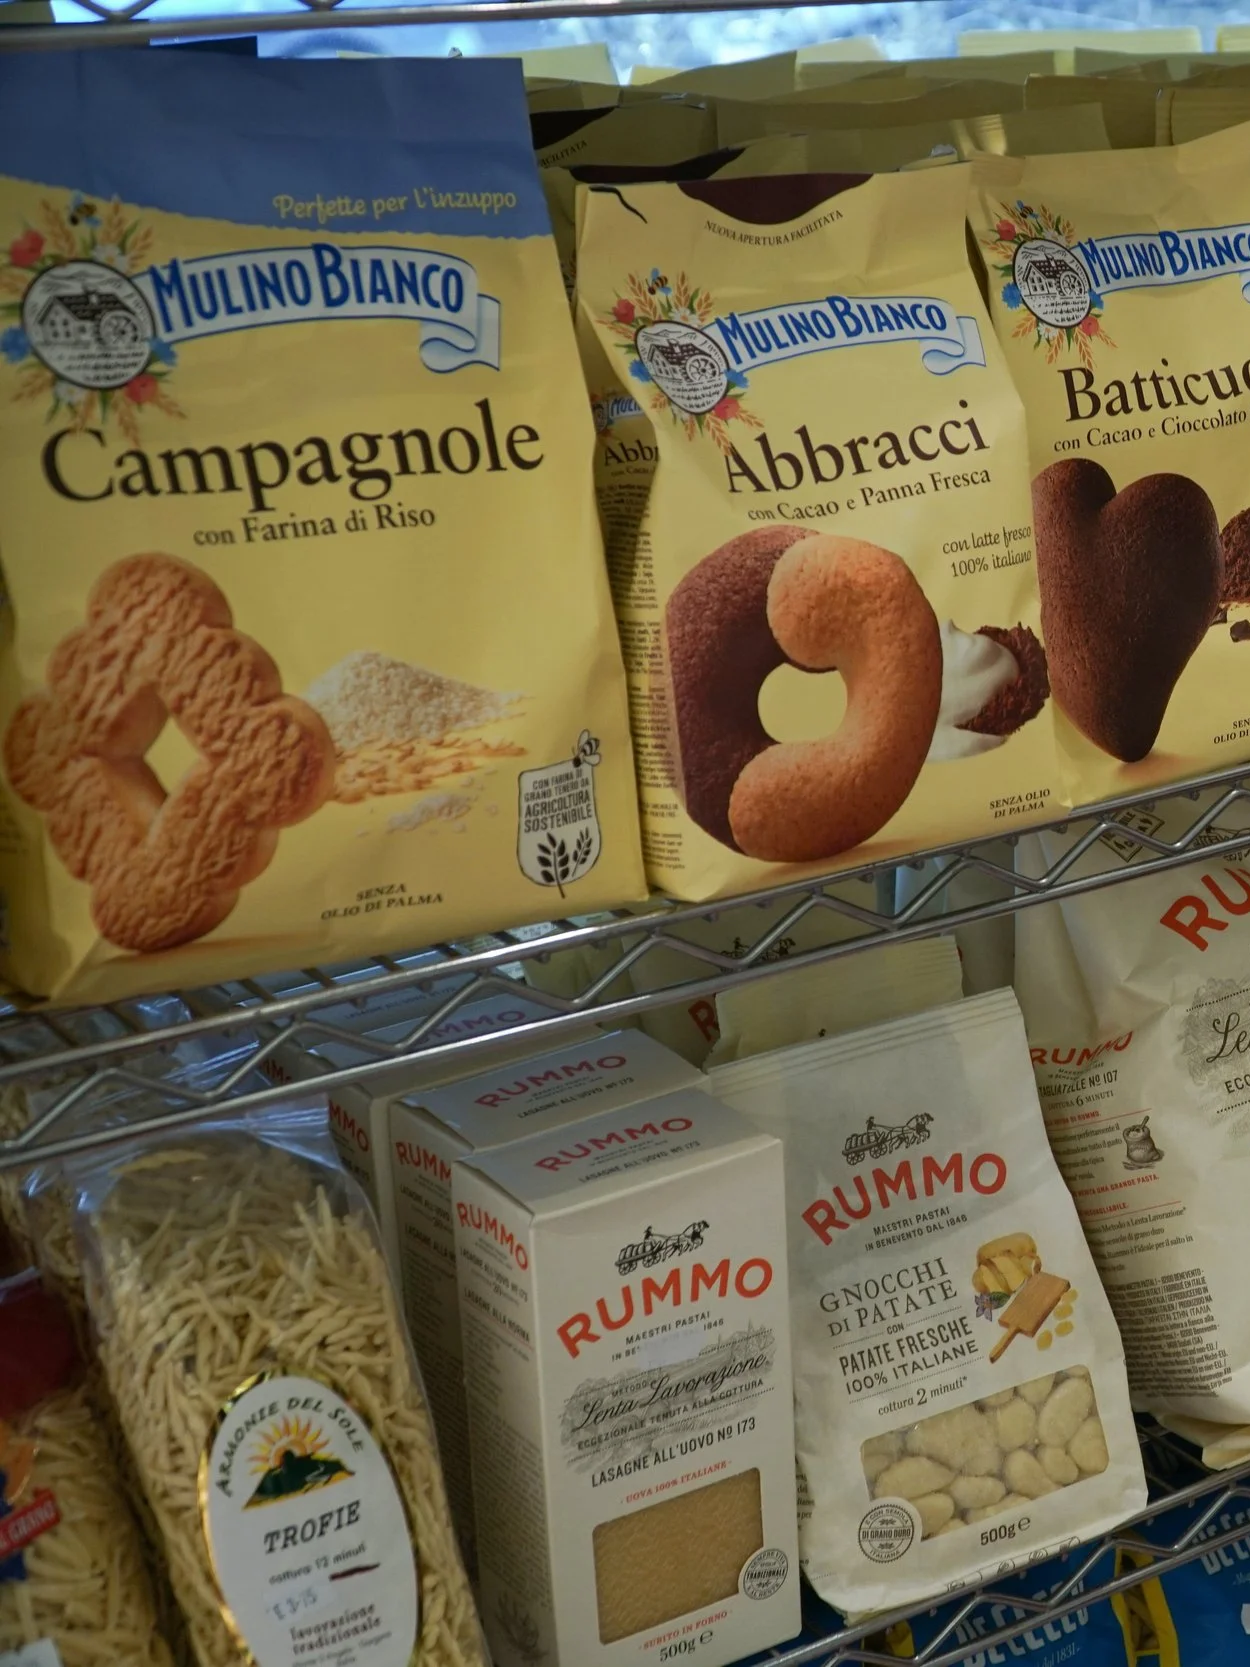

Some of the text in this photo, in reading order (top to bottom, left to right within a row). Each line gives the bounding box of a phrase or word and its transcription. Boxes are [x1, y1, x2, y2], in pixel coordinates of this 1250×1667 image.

[272, 186, 517, 223] Perfette per l'inzuppo
[704, 210, 845, 247] NUOVA APERTURA FACILITATA
[1078, 238, 1166, 288] MULINO
[150, 243, 464, 333] MULINO BIANCO
[727, 399, 990, 494] Abbracci
[1054, 437, 1081, 453] con
[1087, 426, 1142, 447] Cacao
[1148, 428, 1156, 439] e
[1161, 409, 1247, 437] Cioccolato
[42, 398, 544, 513] Campagnole
[748, 466, 991, 522] con Cacao e Panna Fresca
[193, 502, 436, 546] con Farina di Riso
[943, 525, 1032, 555] con latte fresco
[950, 548, 1032, 578] 100% italiano
[1213, 732, 1236, 744] OLIO
[1238, 728, 1250, 739] DI
[524, 778, 589, 802] GRANO TENERO DA
[525, 790, 590, 818] AGRICOLTURA
[989, 788, 1051, 810] SENZA OLIO
[321, 893, 443, 920] OLIO DI PALMA
[356, 883, 407, 901] SENZA
[1030, 1031, 1133, 1066] RUMMO
[475, 1055, 626, 1108] RUMMO
[534, 1118, 693, 1172] RUMMO
[802, 1153, 1007, 1246] RUMMO
[1110, 1180, 1136, 1191] GRANDE
[1137, 1174, 1160, 1184] PASTA.
[456, 1202, 529, 1271] RUMMO
[873, 1206, 950, 1237] MAESTRI PASTAI
[1127, 1232, 1133, 1241] di
[1133, 1231, 1151, 1242] grano
[819, 1257, 949, 1314] GNOCCHI
[556, 1258, 773, 1360] RUMMO
[626, 1311, 711, 1346] MAESTRI PASTAI
[829, 1279, 957, 1338] DI PATATE
[839, 1315, 973, 1376] PATATE FRESCHE
[846, 1339, 979, 1395] 100% ITALIANE
[571, 1354, 769, 1433] Lenta Lavorazione
[878, 1394, 914, 1416] cottura
[916, 1387, 928, 1407] 2
[215, 1396, 366, 1498] ARMONIE DEL SOLE
[625, 1463, 727, 1504] UOVA 100% ITALIANE
[263, 1500, 361, 1556] TROFIE
[980, 1524, 1017, 1547] 500g
[269, 1565, 312, 1586] cottura
[333, 1541, 365, 1564] minuti
[643, 1610, 729, 1651] SUBITO IN FORNO
[660, 1638, 697, 1662] 500g
